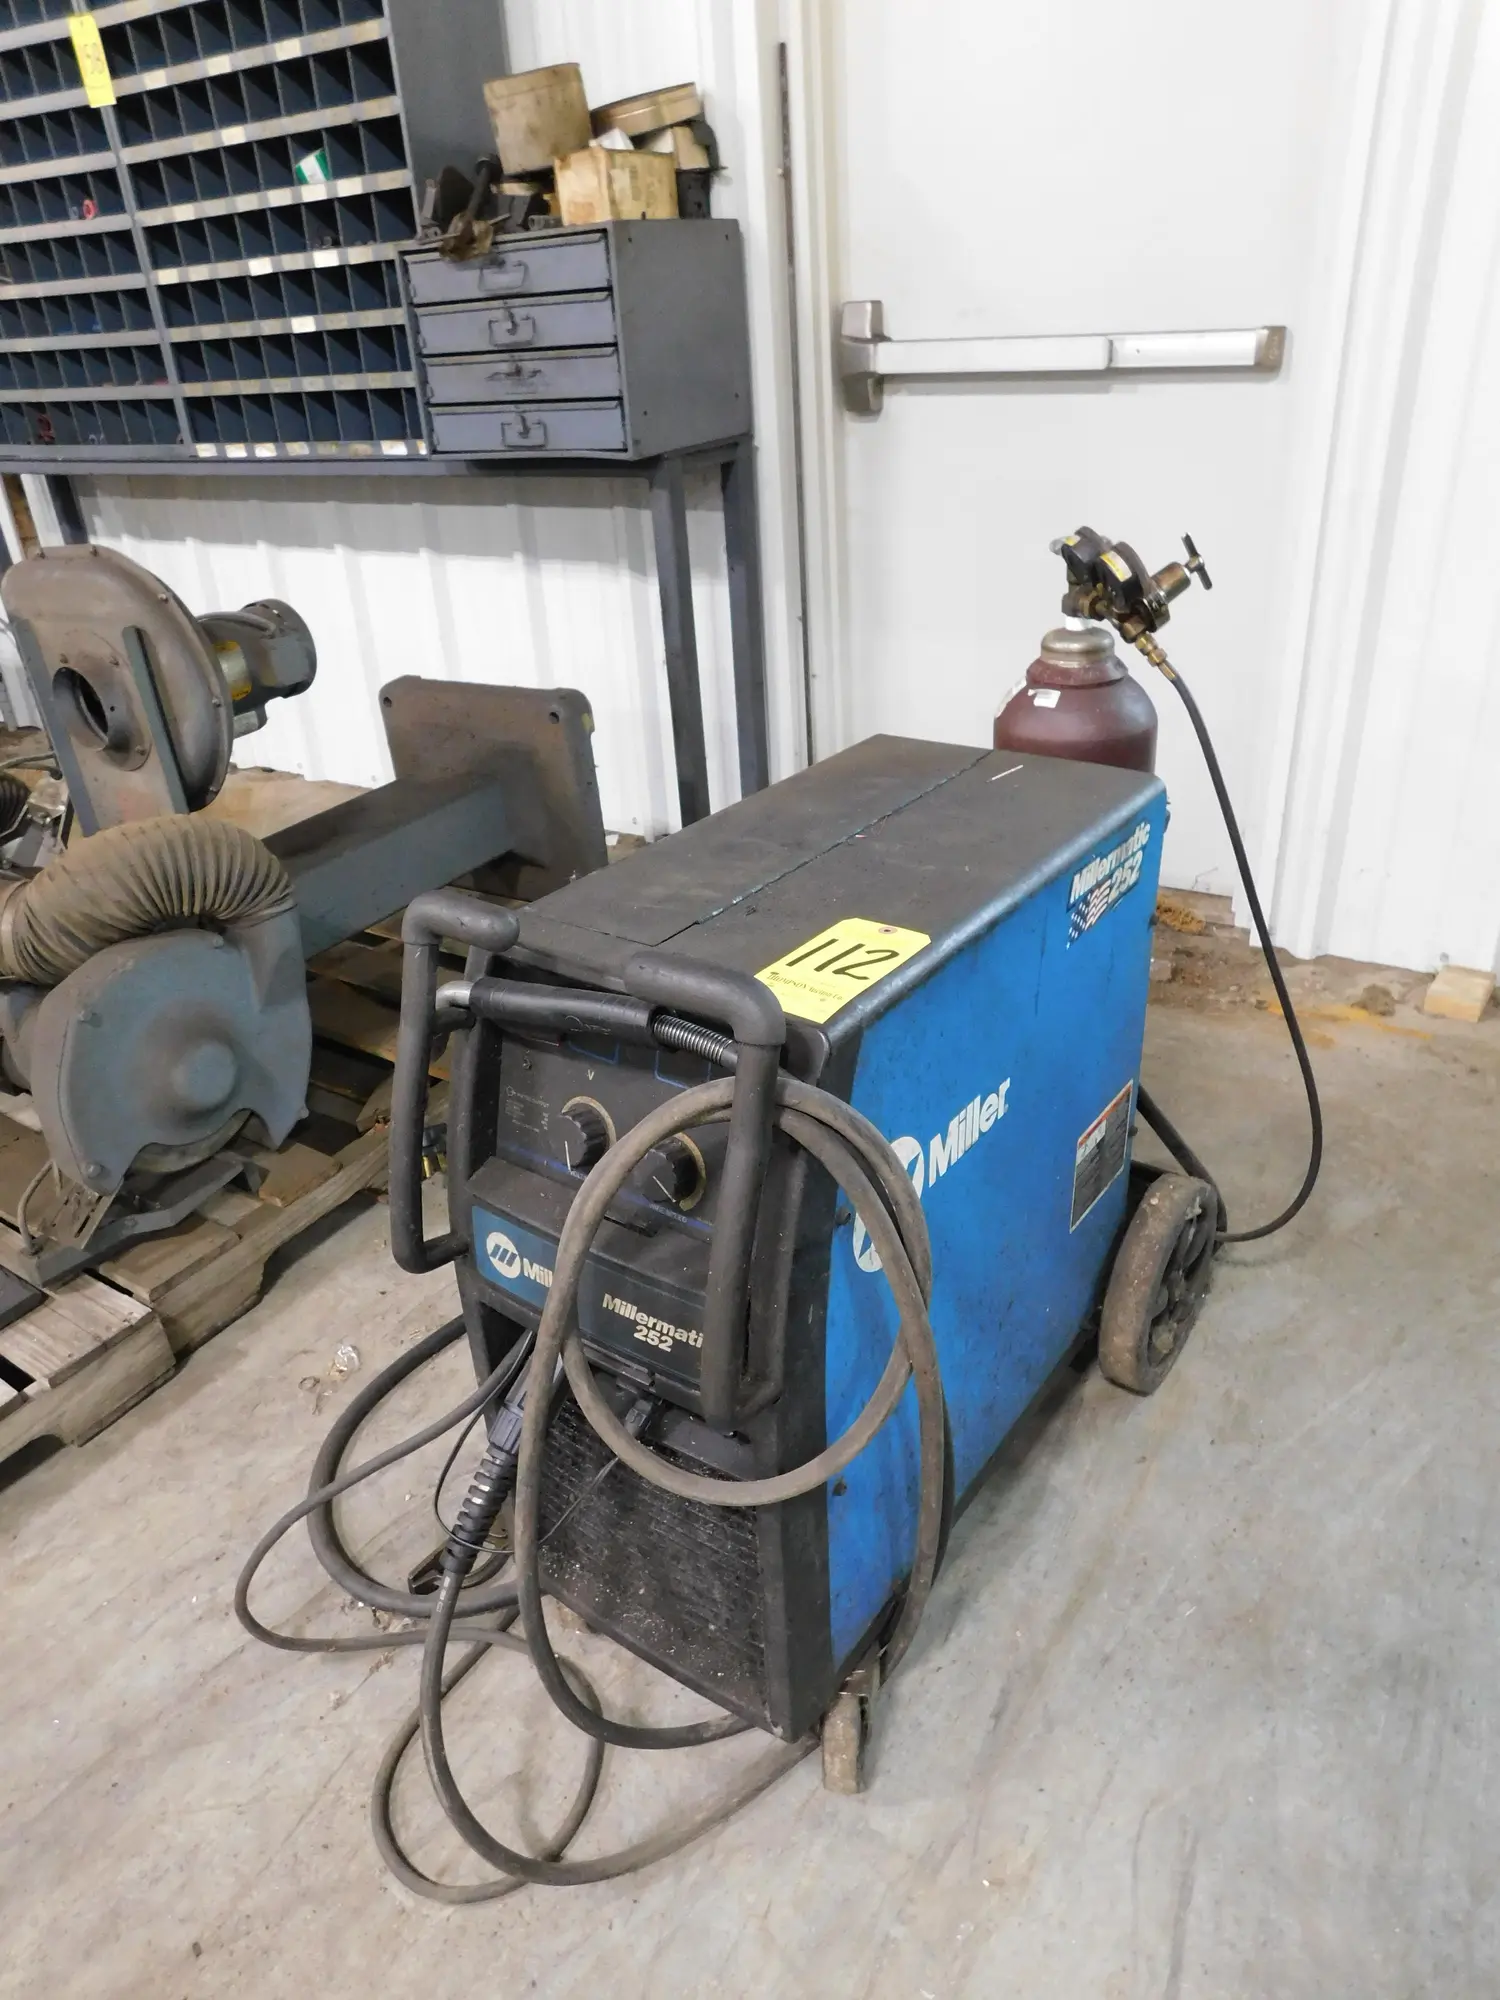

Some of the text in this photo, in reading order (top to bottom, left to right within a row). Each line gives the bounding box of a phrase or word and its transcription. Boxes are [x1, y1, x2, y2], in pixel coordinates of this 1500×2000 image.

[1070, 821, 1151, 904] Millermatic
[1108, 849, 1144, 903] 252
[785, 938, 900, 981] 112
[587, 1069, 595, 1081] V
[929, 1077, 1011, 1188] Miller
[523, 1257, 553, 1288] Mill
[602, 1293, 704, 1348] Millermati
[633, 1325, 673, 1353] 252
